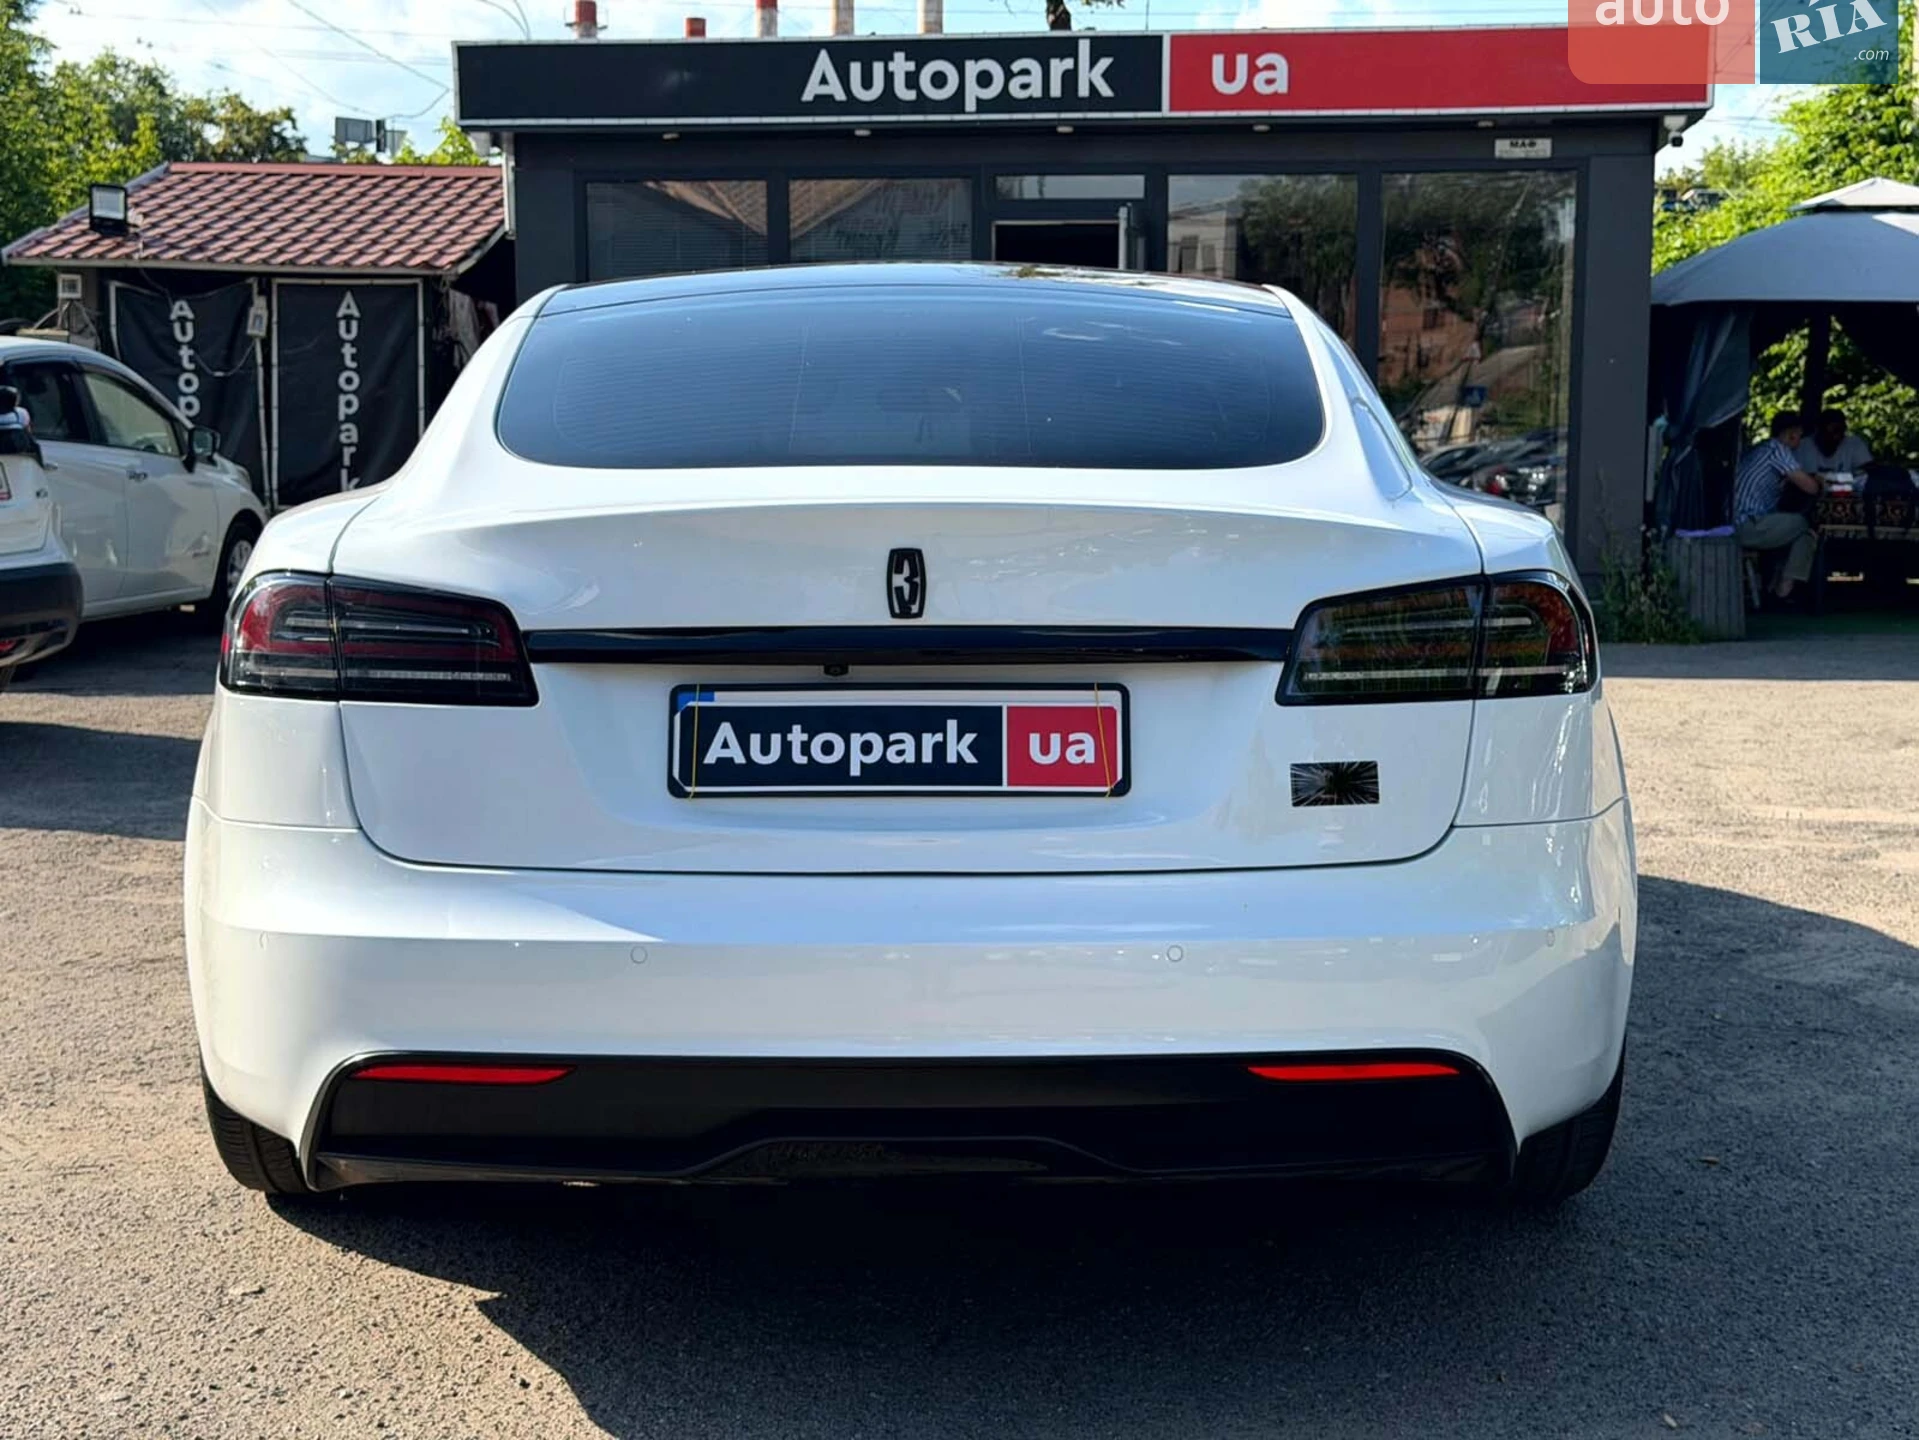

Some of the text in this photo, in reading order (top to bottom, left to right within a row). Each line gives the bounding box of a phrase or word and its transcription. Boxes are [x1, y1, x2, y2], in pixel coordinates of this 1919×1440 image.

[801, 38, 1289, 113] Autopark ua
[703, 719, 1096, 777] Autopark ua
